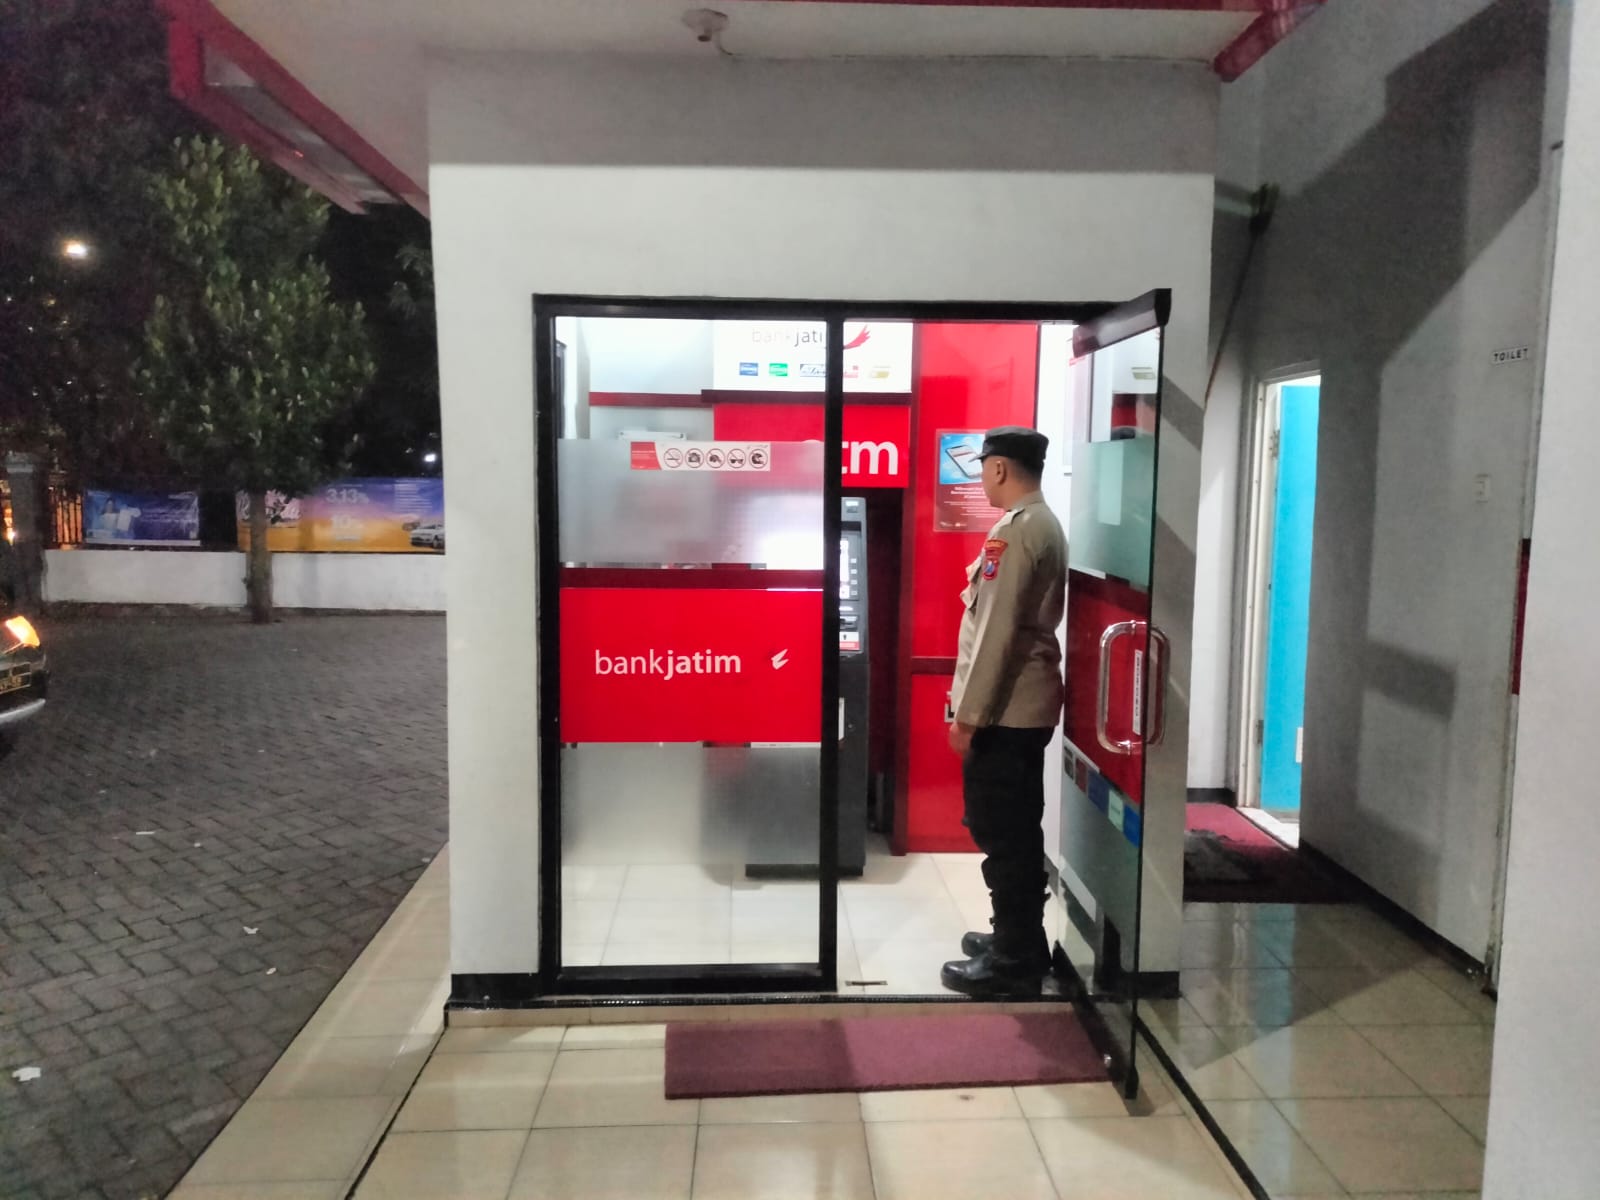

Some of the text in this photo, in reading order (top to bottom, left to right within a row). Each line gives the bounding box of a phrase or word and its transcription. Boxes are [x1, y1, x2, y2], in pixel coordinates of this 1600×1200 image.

[752, 328, 824, 347] bankjati
[1494, 348, 1528, 361] TOILET
[595, 648, 742, 681] bankjatim
